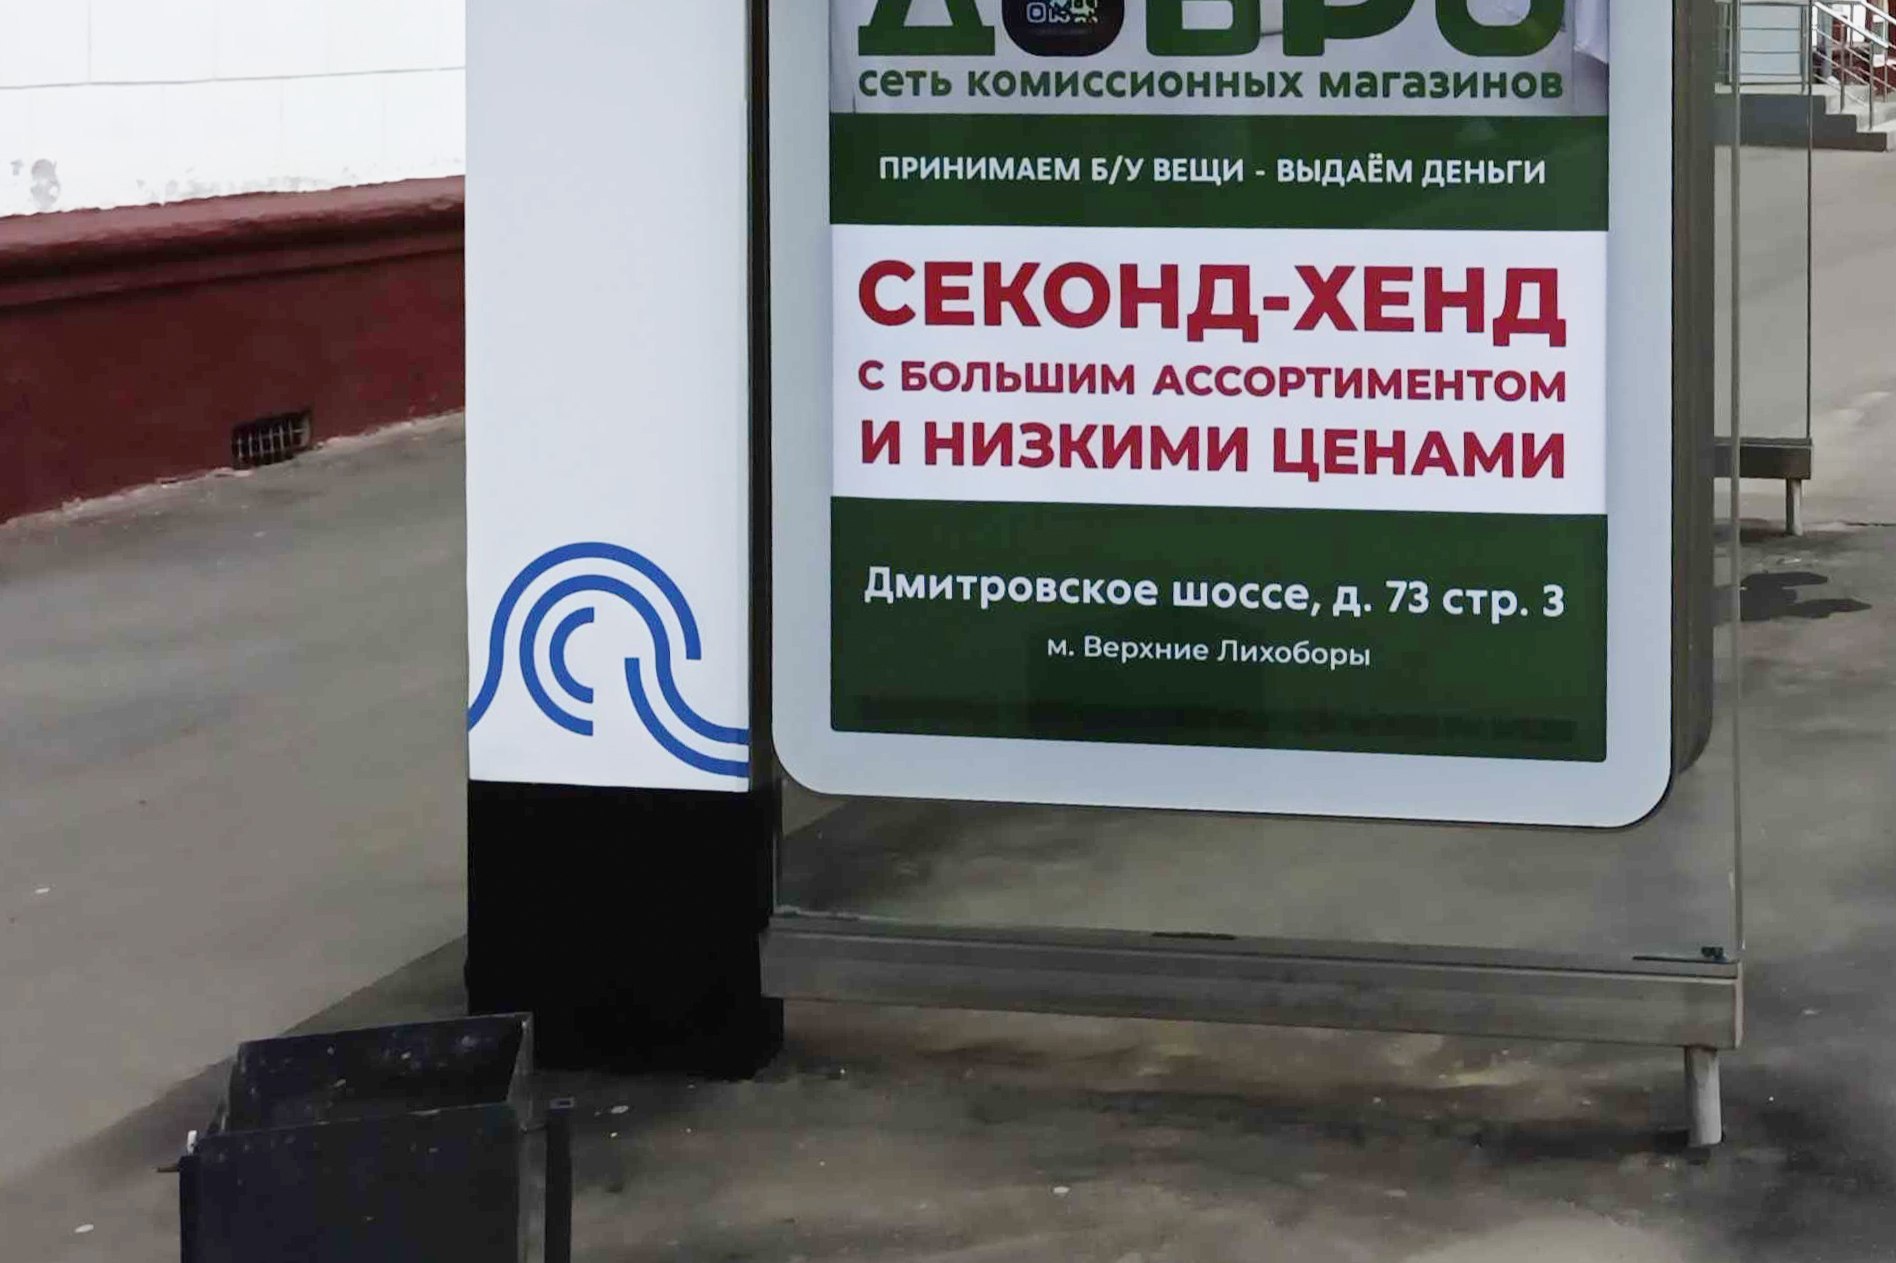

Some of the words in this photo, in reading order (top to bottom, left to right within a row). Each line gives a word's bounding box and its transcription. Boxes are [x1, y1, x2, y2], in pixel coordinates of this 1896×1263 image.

[858, 66, 952, 98] сеть
[967, 69, 1304, 98] комиссионных
[1319, 71, 1564, 100] магазинов
[879, 156, 1081, 183] ПРИНИМАЕМ
[1091, 155, 1143, 187] Б/У
[1153, 158, 1245, 188] ВЕЩИ
[1277, 152, 1414, 187] ВЫДАЁМ
[1422, 160, 1546, 190] ДЕНЬГИ
[858, 259, 1567, 347] СЕКОНД-ХЕНД
[859, 360, 883, 390] С
[901, 360, 1135, 395] БОЛЬШИМ
[1153, 364, 1567, 402] АССОРТИМЕНТОМ
[862, 420, 900, 464] И
[924, 421, 1249, 472] НИЗКИМИ
[1272, 427, 1565, 482] ЦЕНАМИ
[863, 566, 1159, 609] Дмитровское
[1172, 581, 1321, 617] шоссе,
[1332, 586, 1373, 617] д.
[1386, 580, 1429, 615] 73
[1442, 588, 1529, 622] стр.
[1542, 584, 1565, 617] 3
[1047, 639, 1074, 656] м.
[1083, 635, 1210, 664] Верхние
[1217, 639, 1371, 670] Лихоборы
